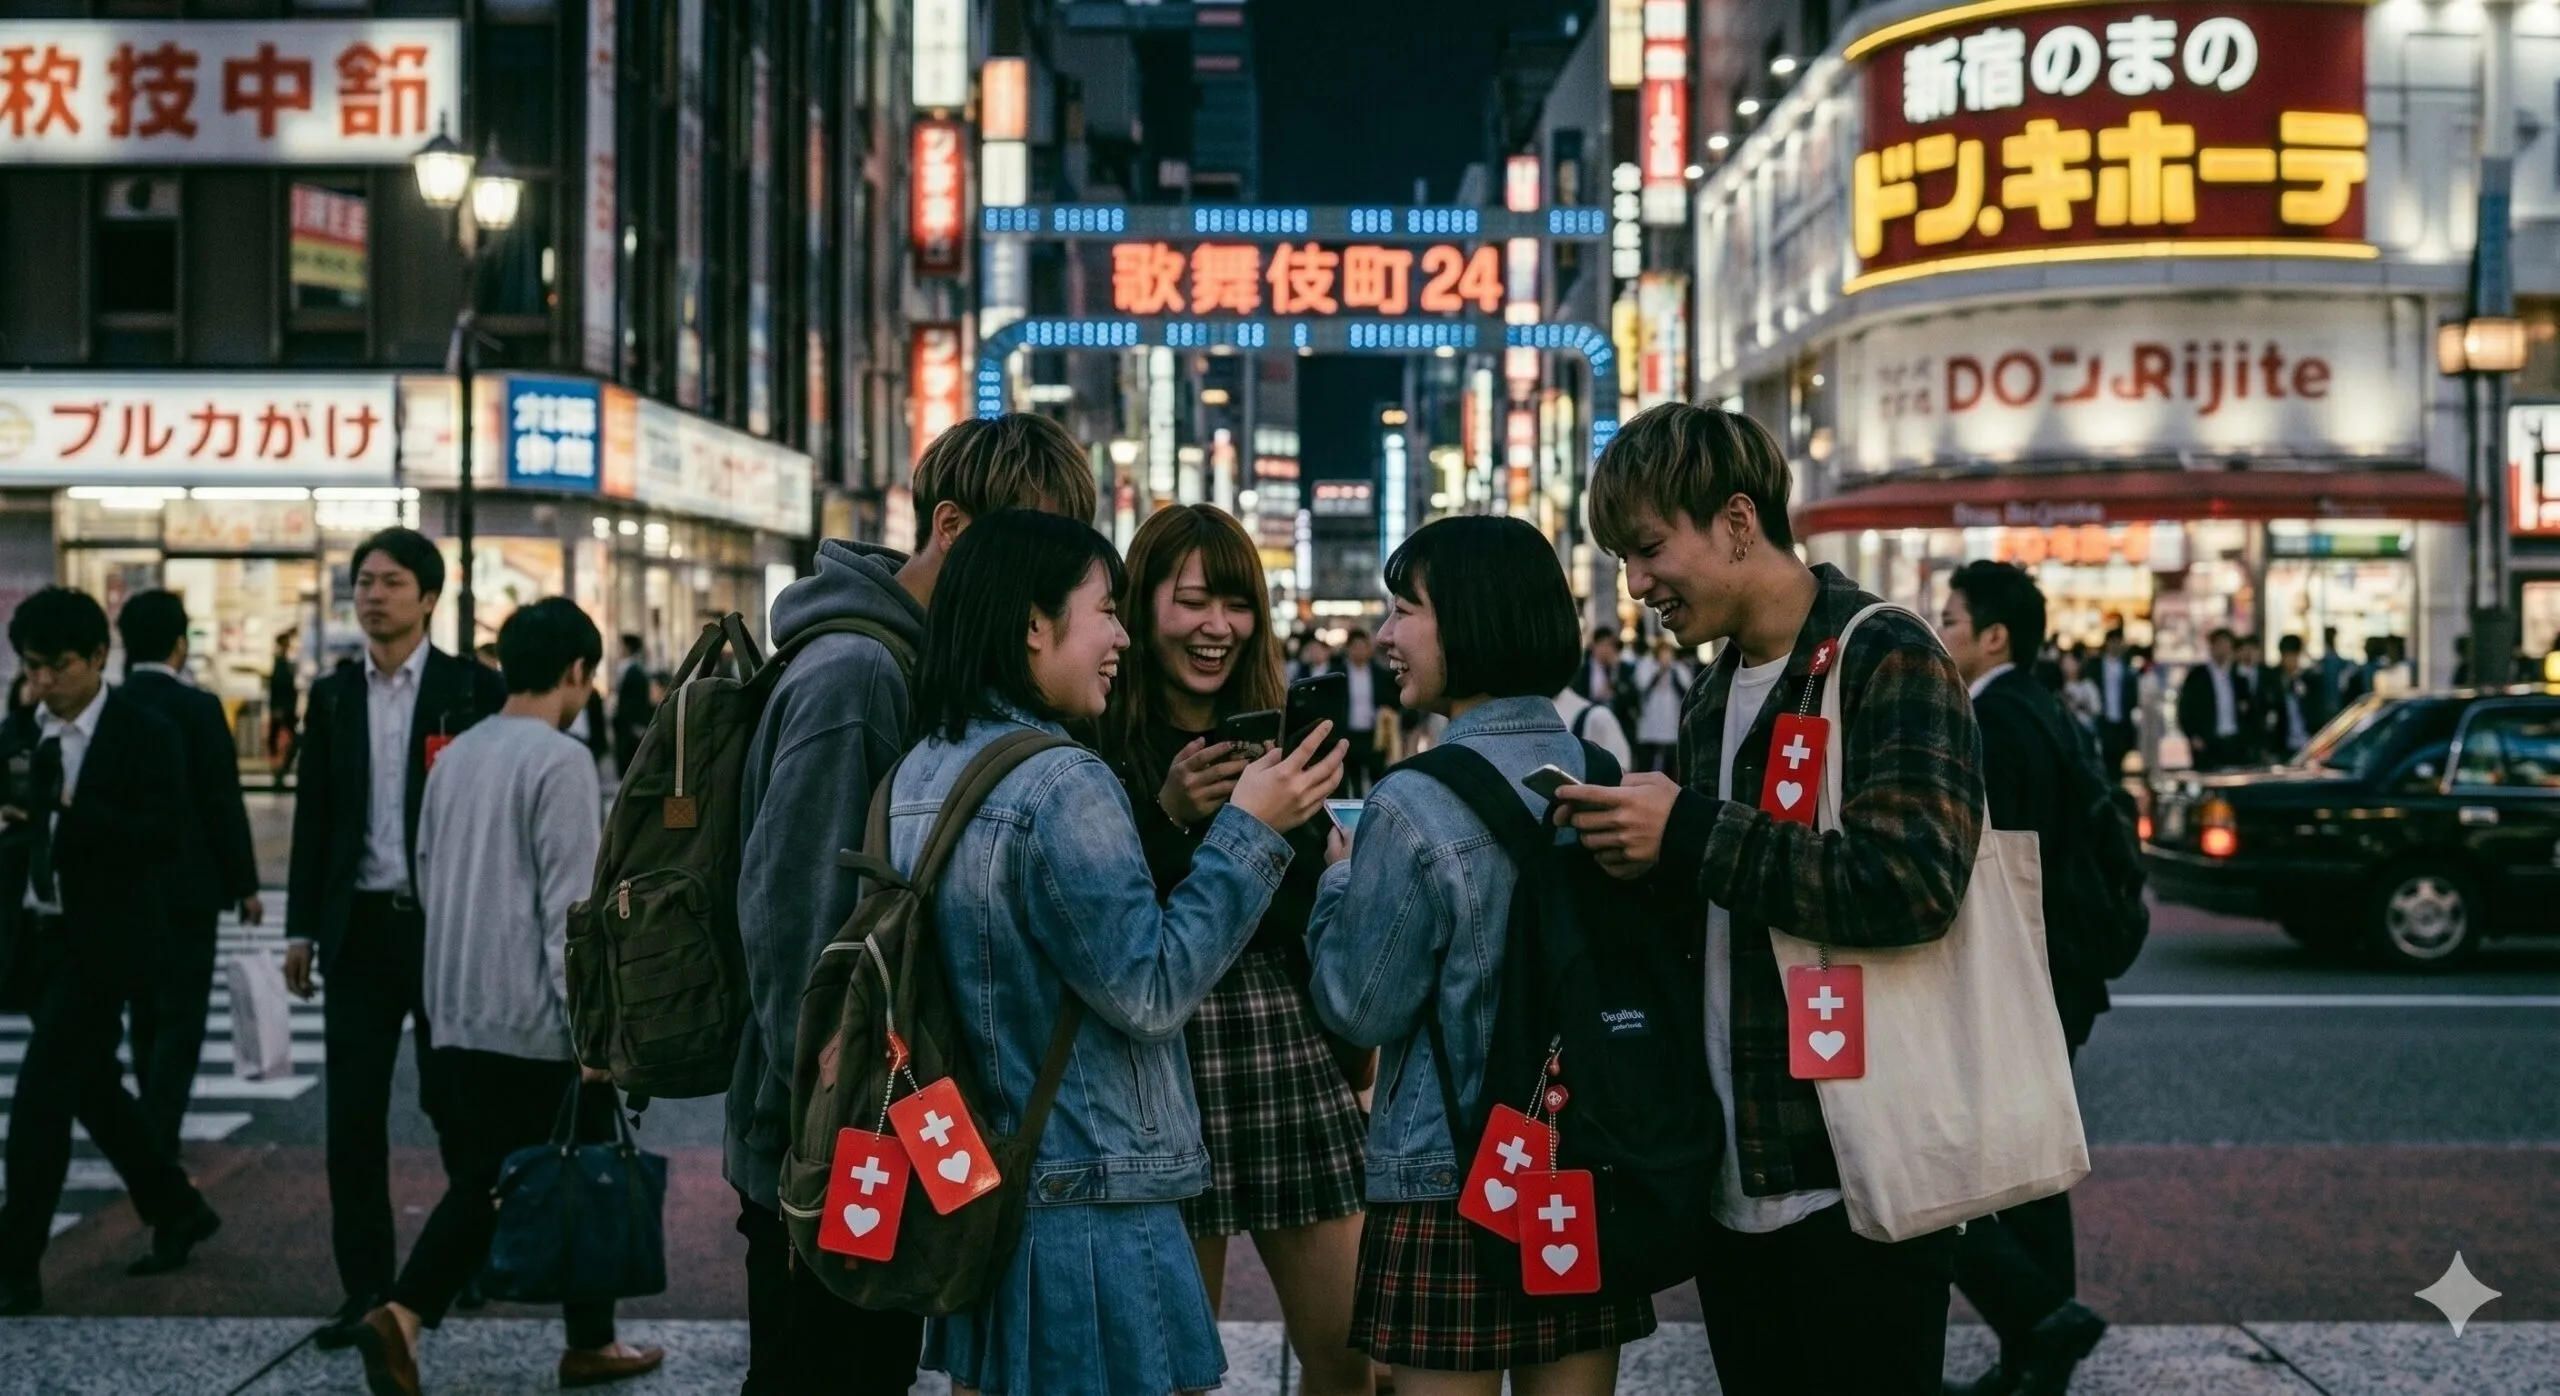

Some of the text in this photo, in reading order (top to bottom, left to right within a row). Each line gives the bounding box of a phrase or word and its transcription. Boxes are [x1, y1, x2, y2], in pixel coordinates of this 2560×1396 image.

[1903, 15, 2259, 123] 新宿のまの
[1111, 242, 1504, 315] 歌舞伎町24
